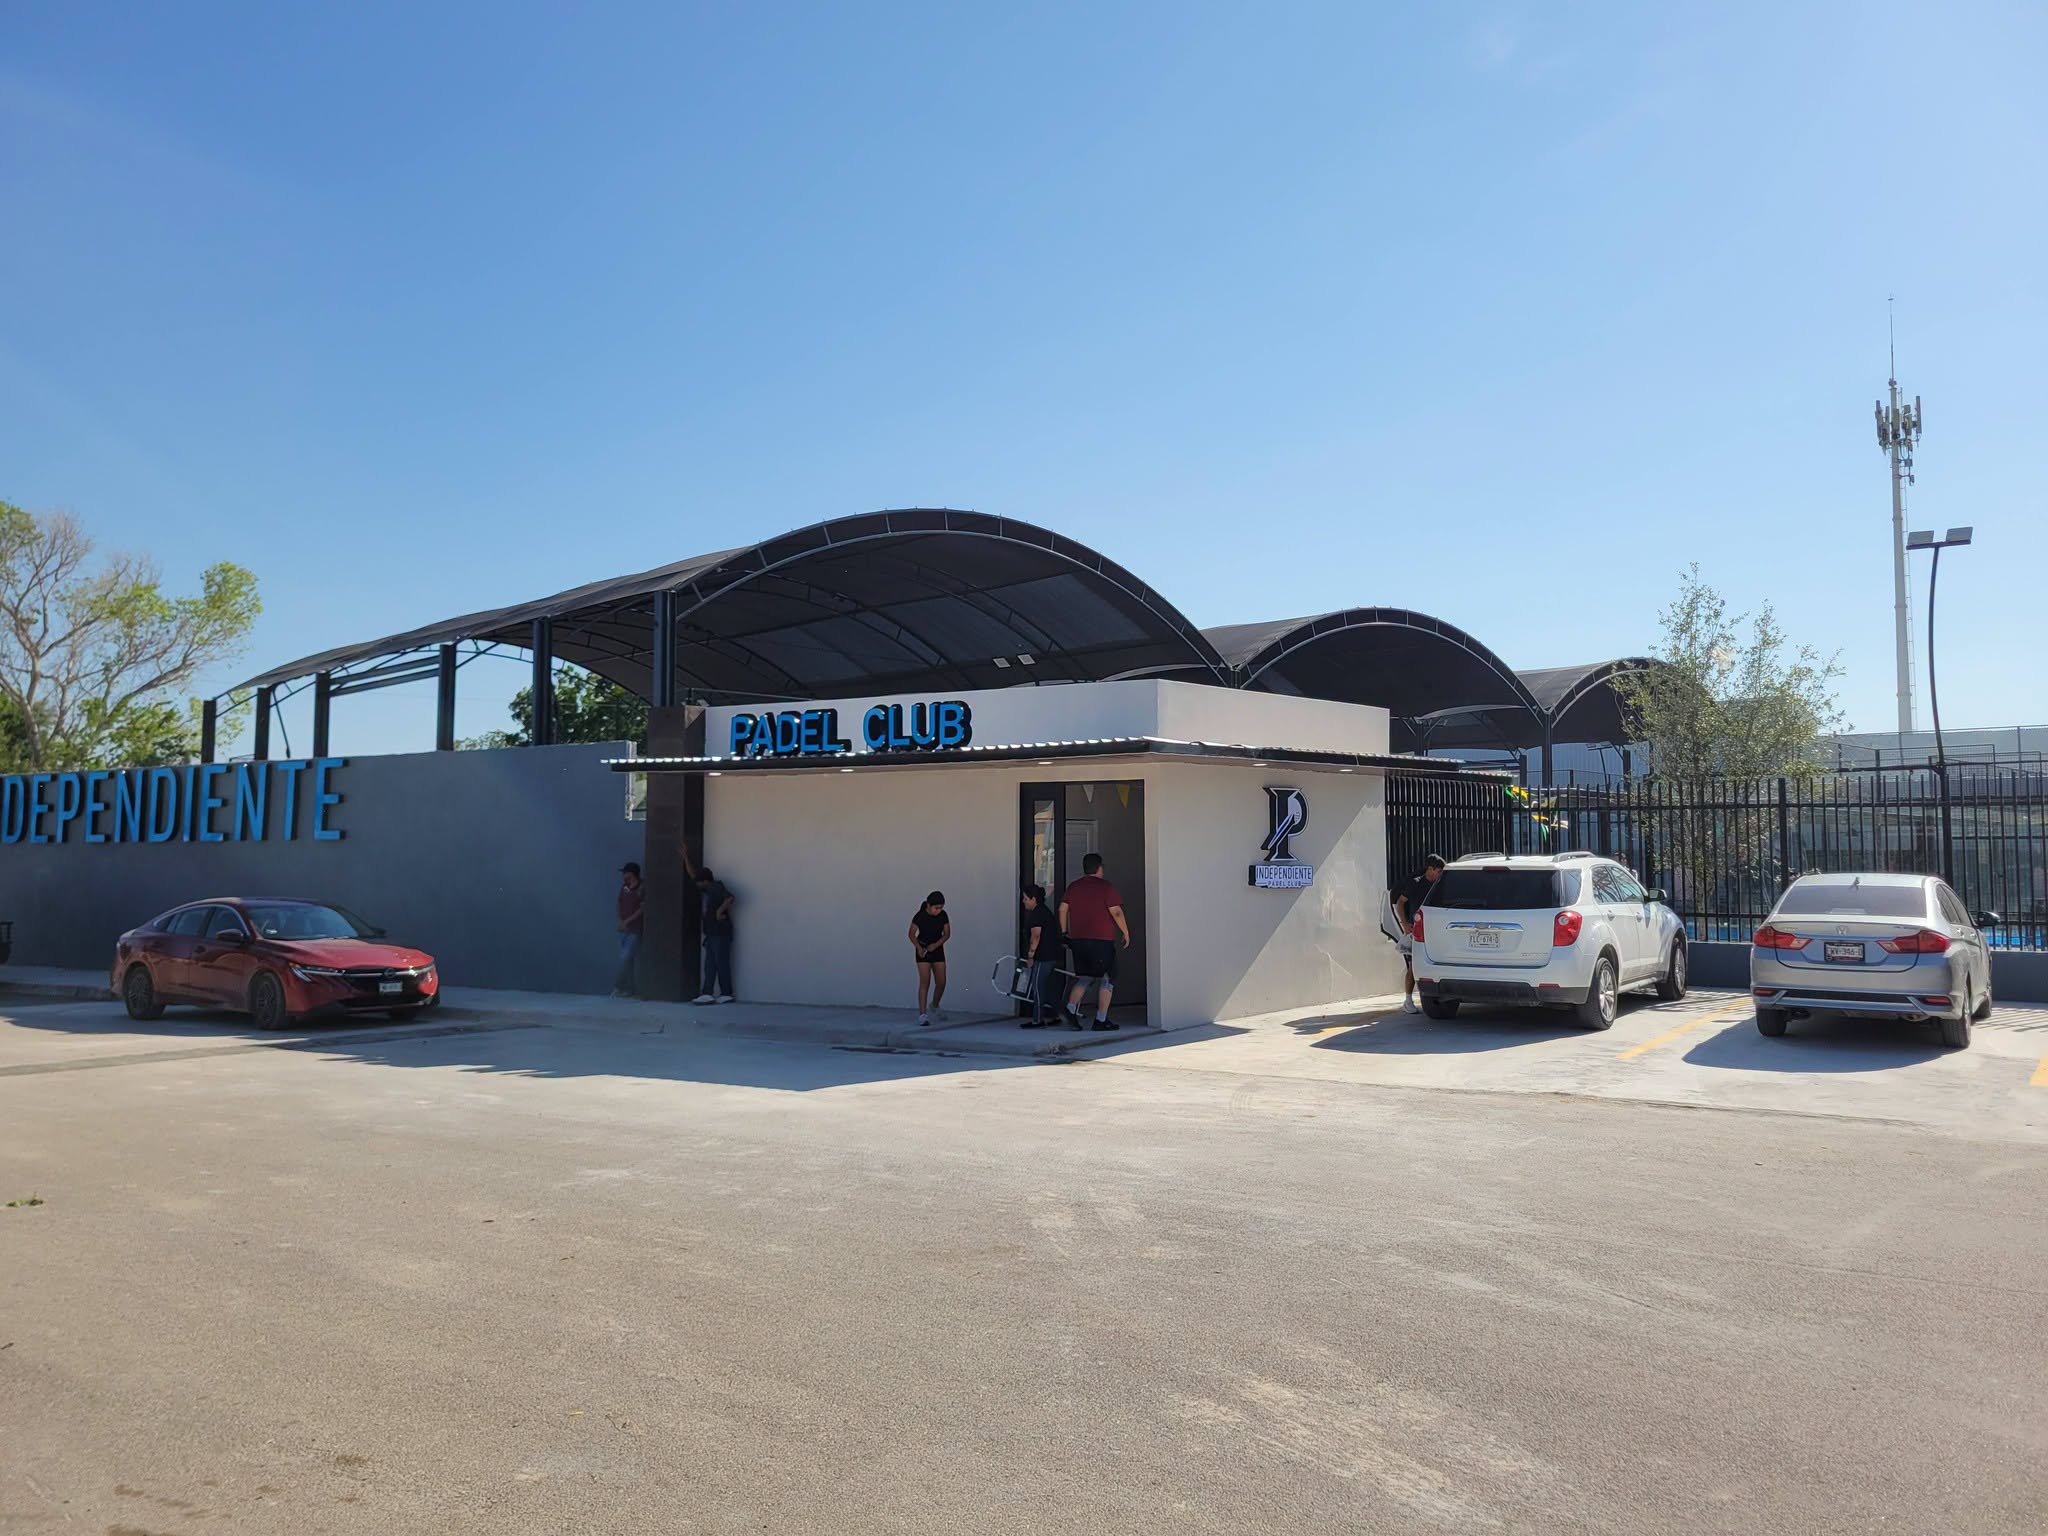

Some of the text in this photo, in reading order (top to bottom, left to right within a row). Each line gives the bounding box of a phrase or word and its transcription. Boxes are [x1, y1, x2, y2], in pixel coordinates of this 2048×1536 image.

[730, 702, 970, 755] PADEL CLUB
[1, 758, 345, 844] DEPENDIENTE
[1256, 867, 1312, 880] INDEPENDIENTE
